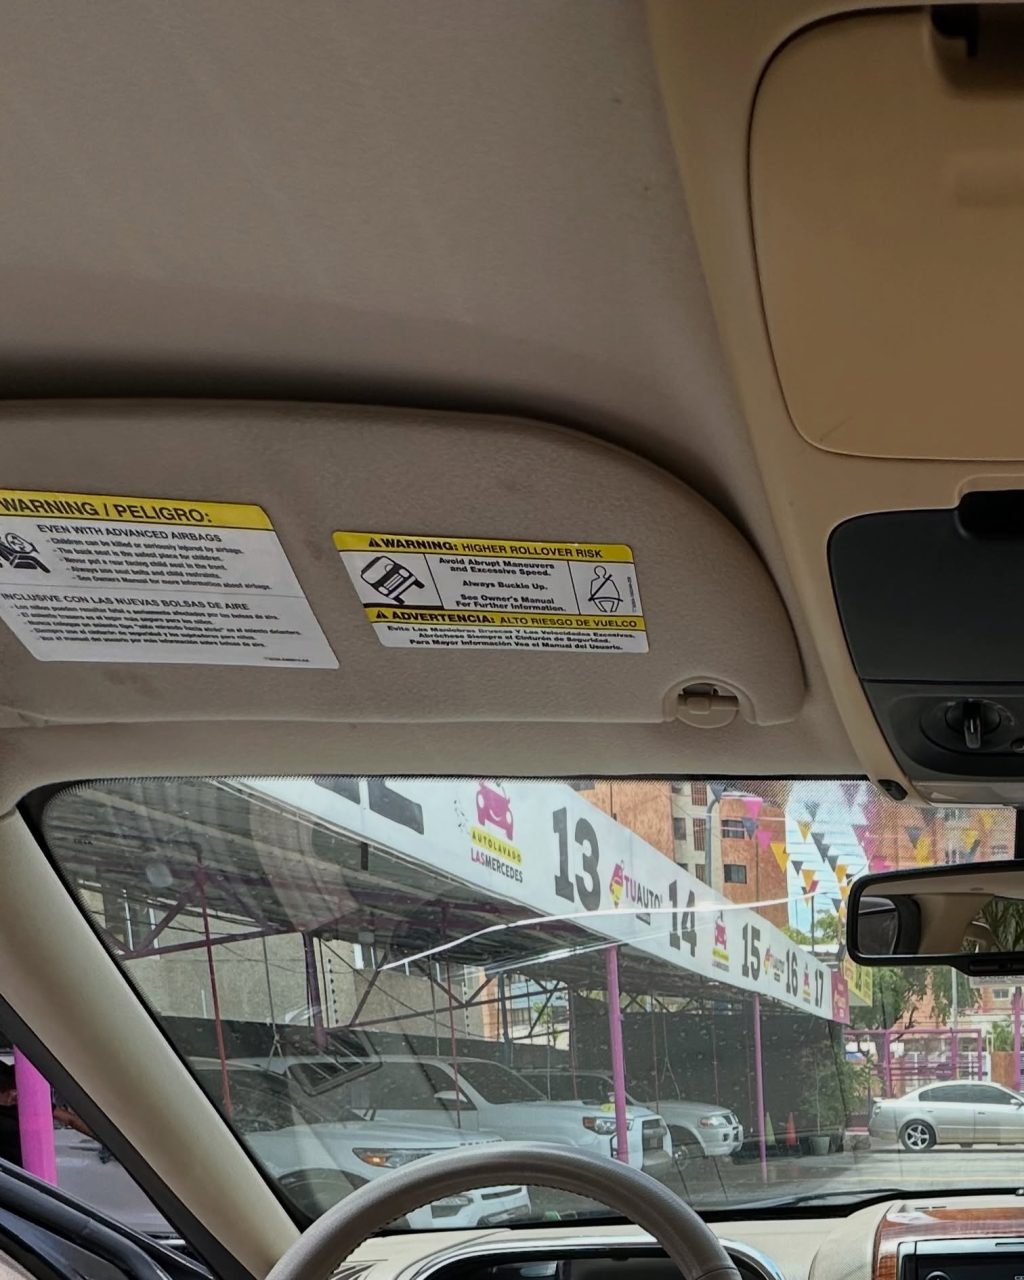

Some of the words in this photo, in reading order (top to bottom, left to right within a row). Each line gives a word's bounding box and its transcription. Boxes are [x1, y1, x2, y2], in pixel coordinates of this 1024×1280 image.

[0, 497, 100, 516] WARNING
[113, 503, 213, 523] PELIGRO:
[36, 524, 71, 534] EVEN
[71, 525, 104, 536] WITH
[105, 527, 168, 540] ADVANCED
[171, 531, 222, 543] AIRBAGS
[380, 538, 459, 551] WARNING:
[461, 543, 507, 555] HIGHER
[510, 545, 573, 557] ROLLOVER
[576, 548, 604, 559] RISK
[439, 557, 466, 566] Avoid
[468, 558, 501, 568] Abrupt
[503, 560, 555, 570] Maneuvers
[450, 565, 468, 573] and
[470, 566, 519, 575] Excessive
[519, 568, 551, 577] Speed.
[462, 580, 495, 588] Always
[497, 581, 531, 590] Buckle
[532, 583, 548, 591] Up.
[0, 592, 62, 603] INCLUSIVE
[63, 594, 89, 604] CON
[90, 596, 114, 605] LAS
[114, 596, 159, 607] NUEVAS
[160, 599, 206, 609] BOLSAS
[207, 601, 223, 610] DE
[224, 602, 250, 611] AIRE
[455, 600, 472, 608] For
[473, 601, 509, 610] Further
[510, 603, 566, 613] Information.
[460, 593, 479, 601] See
[480, 594, 519, 603] Owner's
[520, 596, 555, 604] Manual
[392, 611, 496, 624] ADVERTENCIA:
[500, 615, 529, 625] ALTO
[531, 617, 573, 627] RIESGO
[575, 618, 591, 628] DE
[593, 619, 637, 629] VUELCO
[471, 830, 522, 864] AUTOLAVADO
[470, 847, 524, 884] LASMERCEDES
[552, 806, 602, 912] 13
[668, 879, 697, 958] 14
[741, 922, 761, 981] 15
[785, 948, 798, 995] 16
[814, 968, 824, 1009] 17
